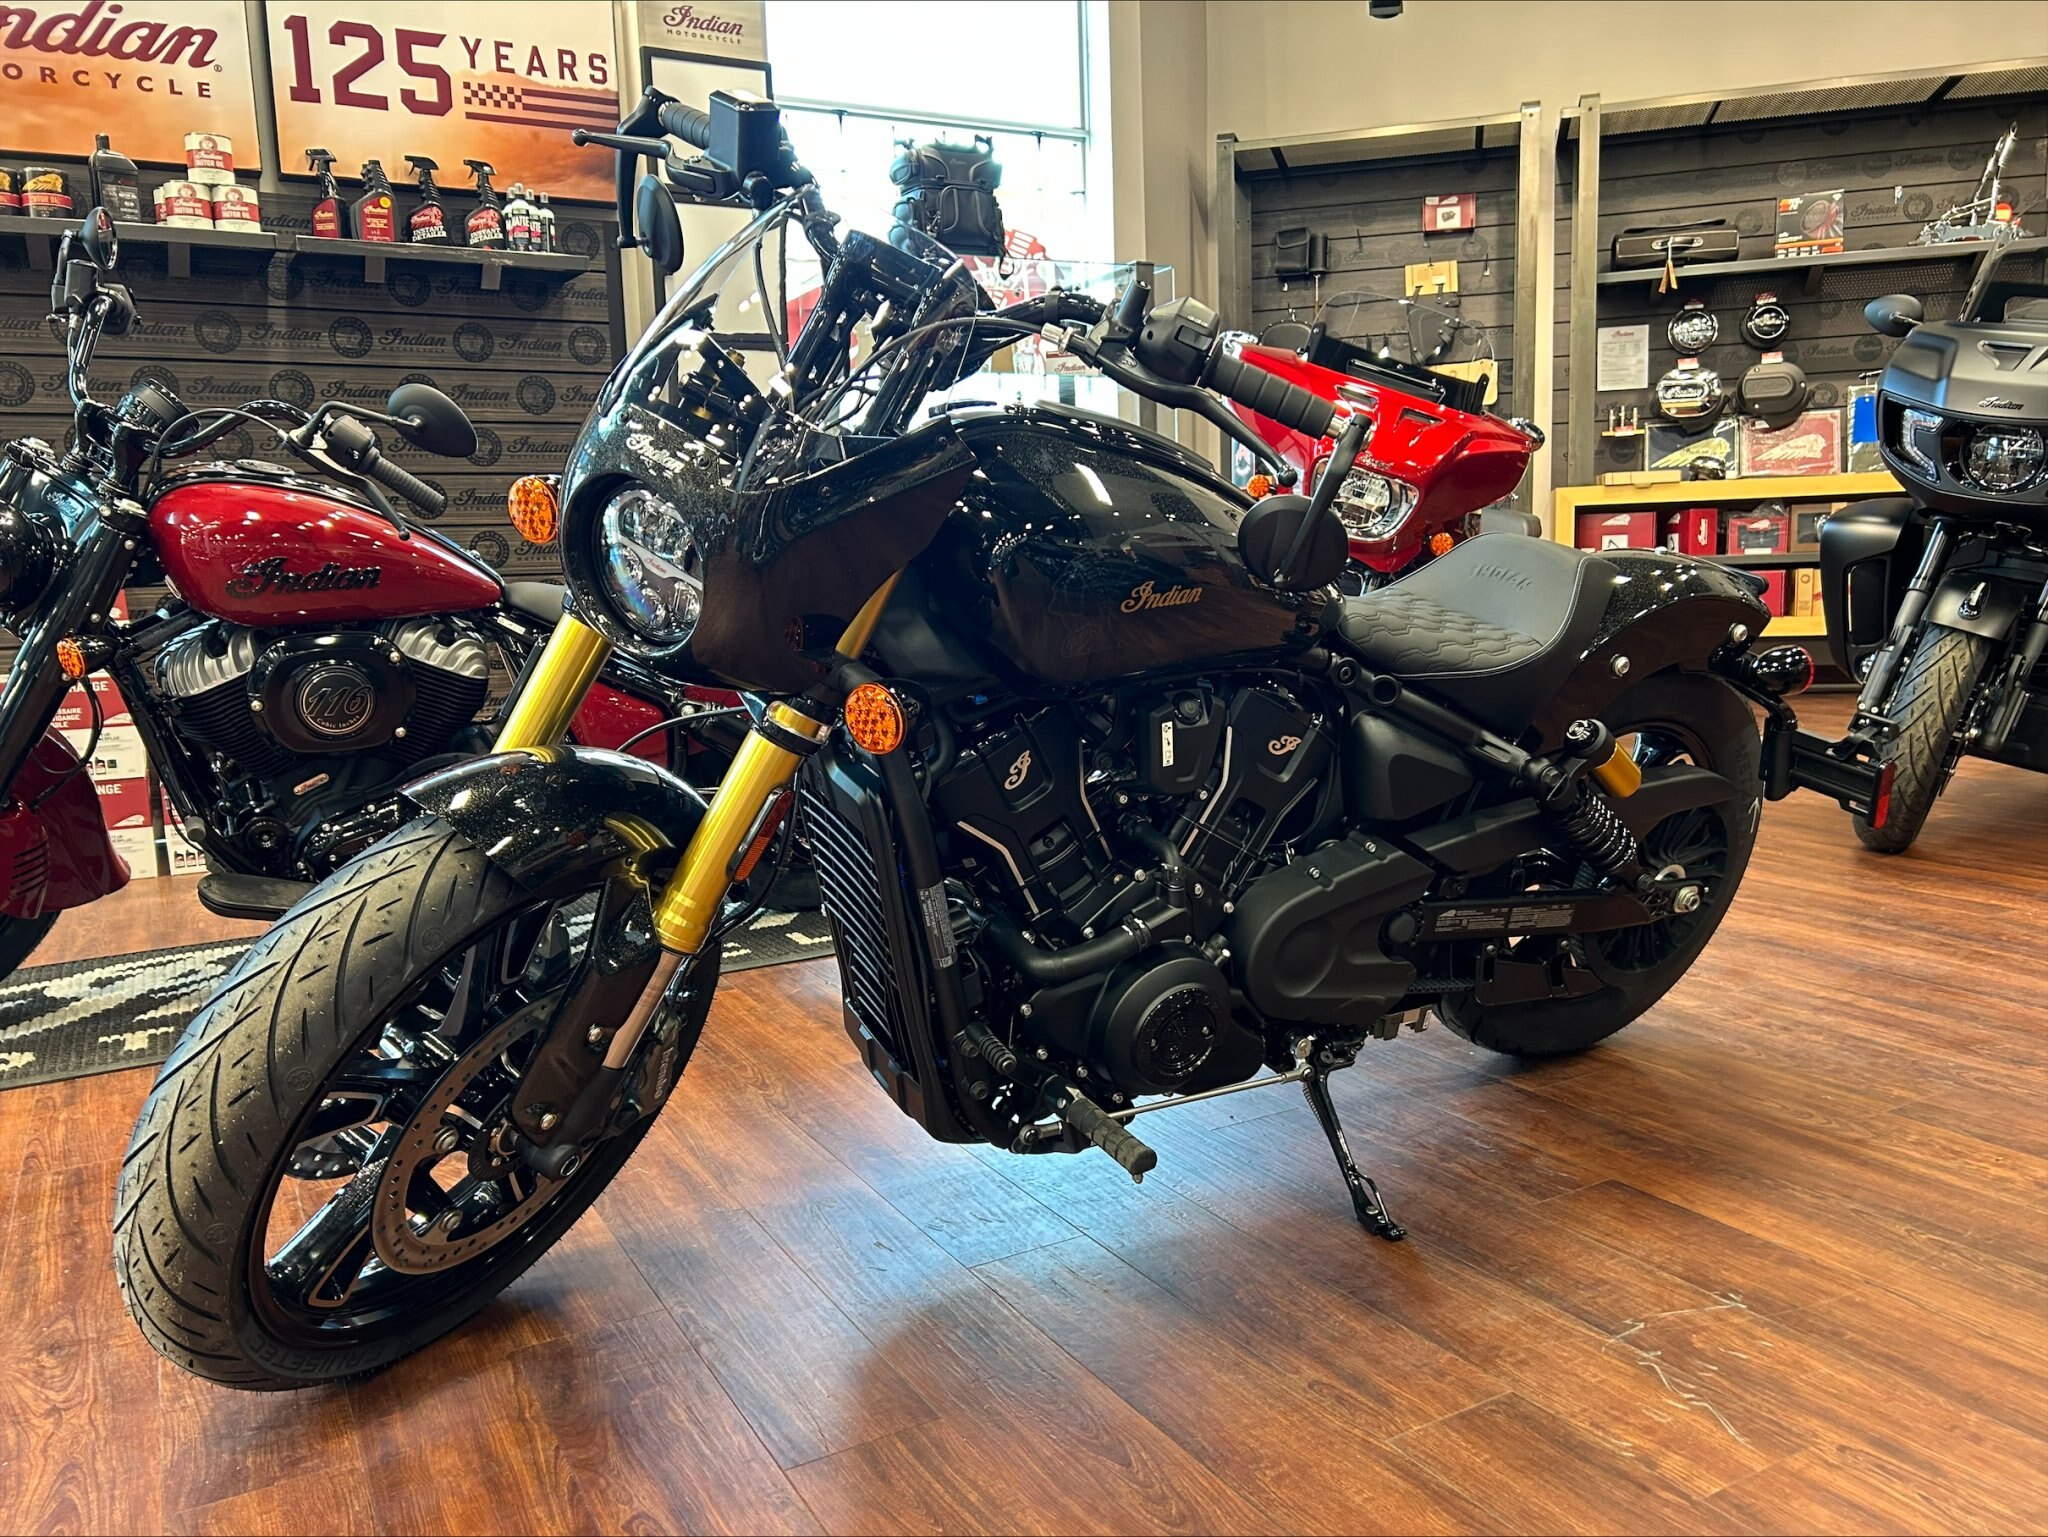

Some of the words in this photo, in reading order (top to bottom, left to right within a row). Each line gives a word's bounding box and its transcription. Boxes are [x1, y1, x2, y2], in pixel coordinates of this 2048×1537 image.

[662, 5, 743, 36] Indian
[0, 0, 218, 68] ndian
[666, 29, 741, 45] MOTORCYCLE
[283, 15, 453, 117] 125
[459, 35, 608, 85] YEARS
[2, 63, 212, 99] ORCYCLE
[194, 159, 215, 167] MOTOR
[216, 160, 225, 168] OIL
[173, 206, 194, 215] MOTOR
[194, 208, 204, 216] OIL
[221, 210, 241, 219] MOTOR
[241, 211, 251, 219] OIL
[259, 211, 311, 230] ndian
[412, 226, 445, 236] INSTANT
[412, 231, 447, 242] DETAILER
[469, 232, 504, 245] DETAILER
[470, 227, 501, 238] INSTANT
[0, 316, 41, 331] dian
[131, 321, 188, 337] ndian
[248, 321, 322, 342] Indian
[378, 327, 446, 347] Indian
[500, 332, 562, 351] Indian
[1055, 361, 1086, 373] Indian
[41, 372, 122, 392] Idian
[186, 376, 262, 395] Indian
[320, 380, 393, 399] Indian
[446, 383, 510, 402] Indian
[1978, 396, 2024, 411] Indian
[507, 436, 571, 455] Indian
[626, 432, 685, 474] Indian
[515, 540, 560, 556] Indi
[643, 555, 667, 575] Indian
[225, 555, 382, 600] Indian
[1120, 580, 1203, 613] Indian
[304, 684, 374, 717] 116
[97, 783, 123, 795] NGE
[654, 1046, 675, 1100] brembo
